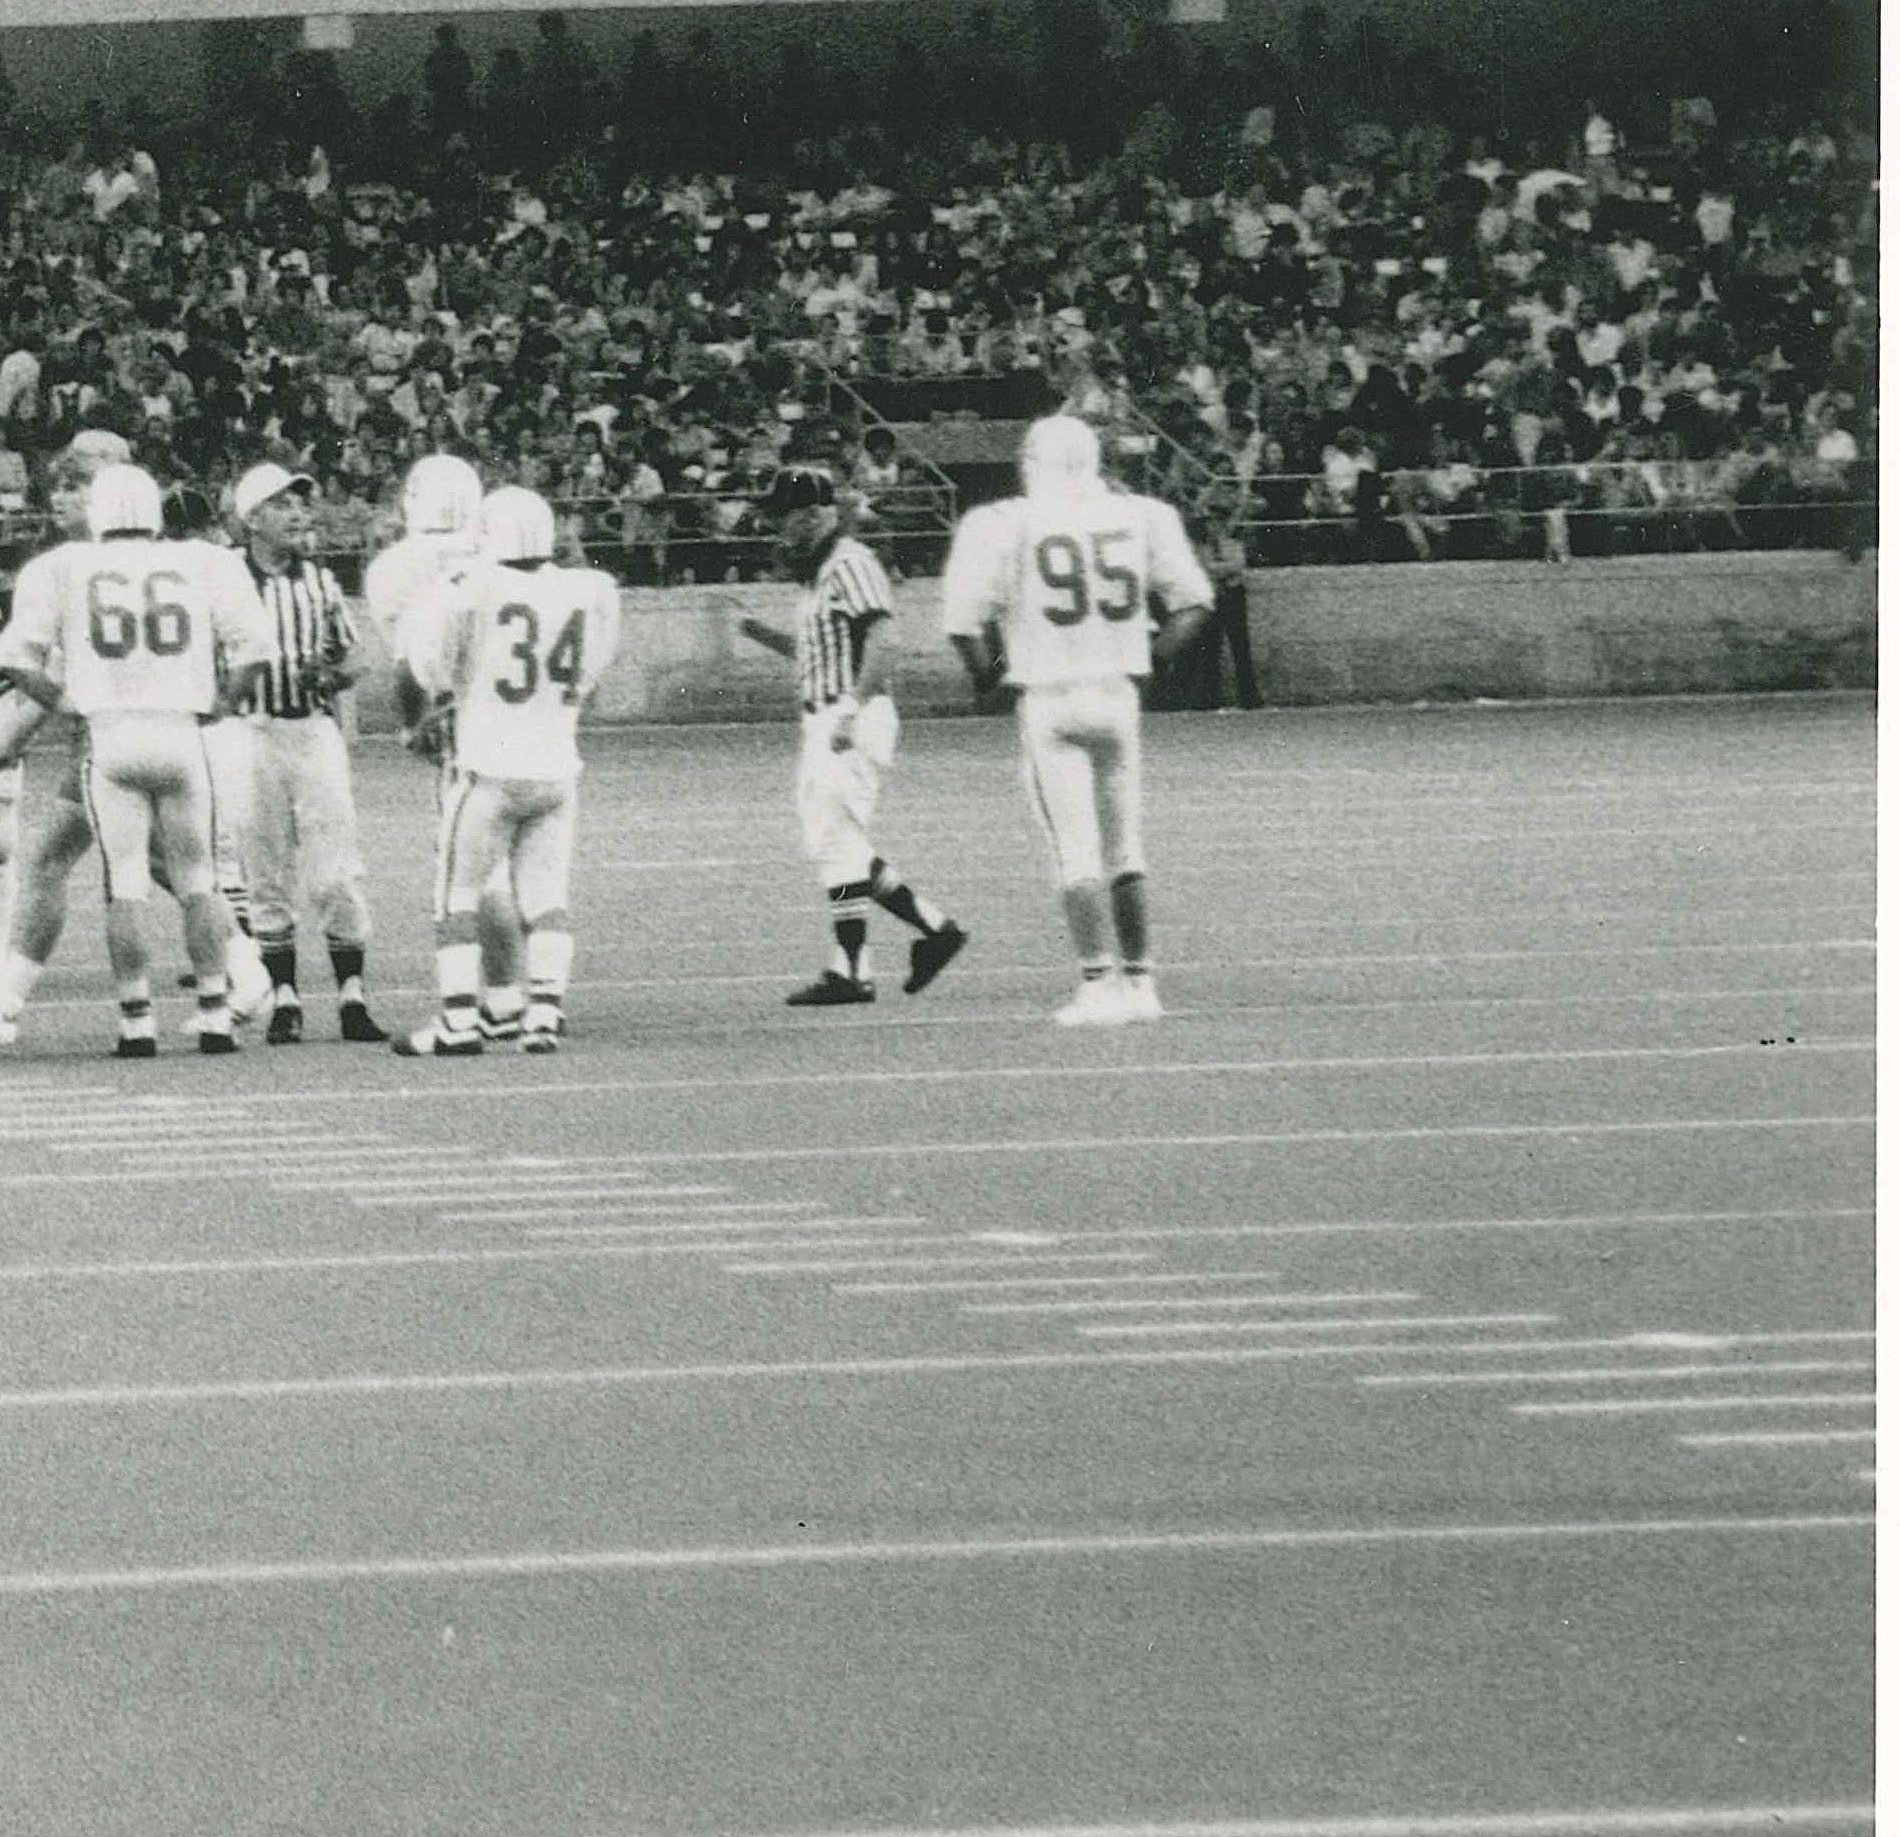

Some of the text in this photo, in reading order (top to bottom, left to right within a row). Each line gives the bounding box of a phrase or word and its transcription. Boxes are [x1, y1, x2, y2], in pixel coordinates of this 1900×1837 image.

[87, 569, 193, 660] 66
[1034, 530, 1141, 627] 95
[496, 603, 586, 707] 34
